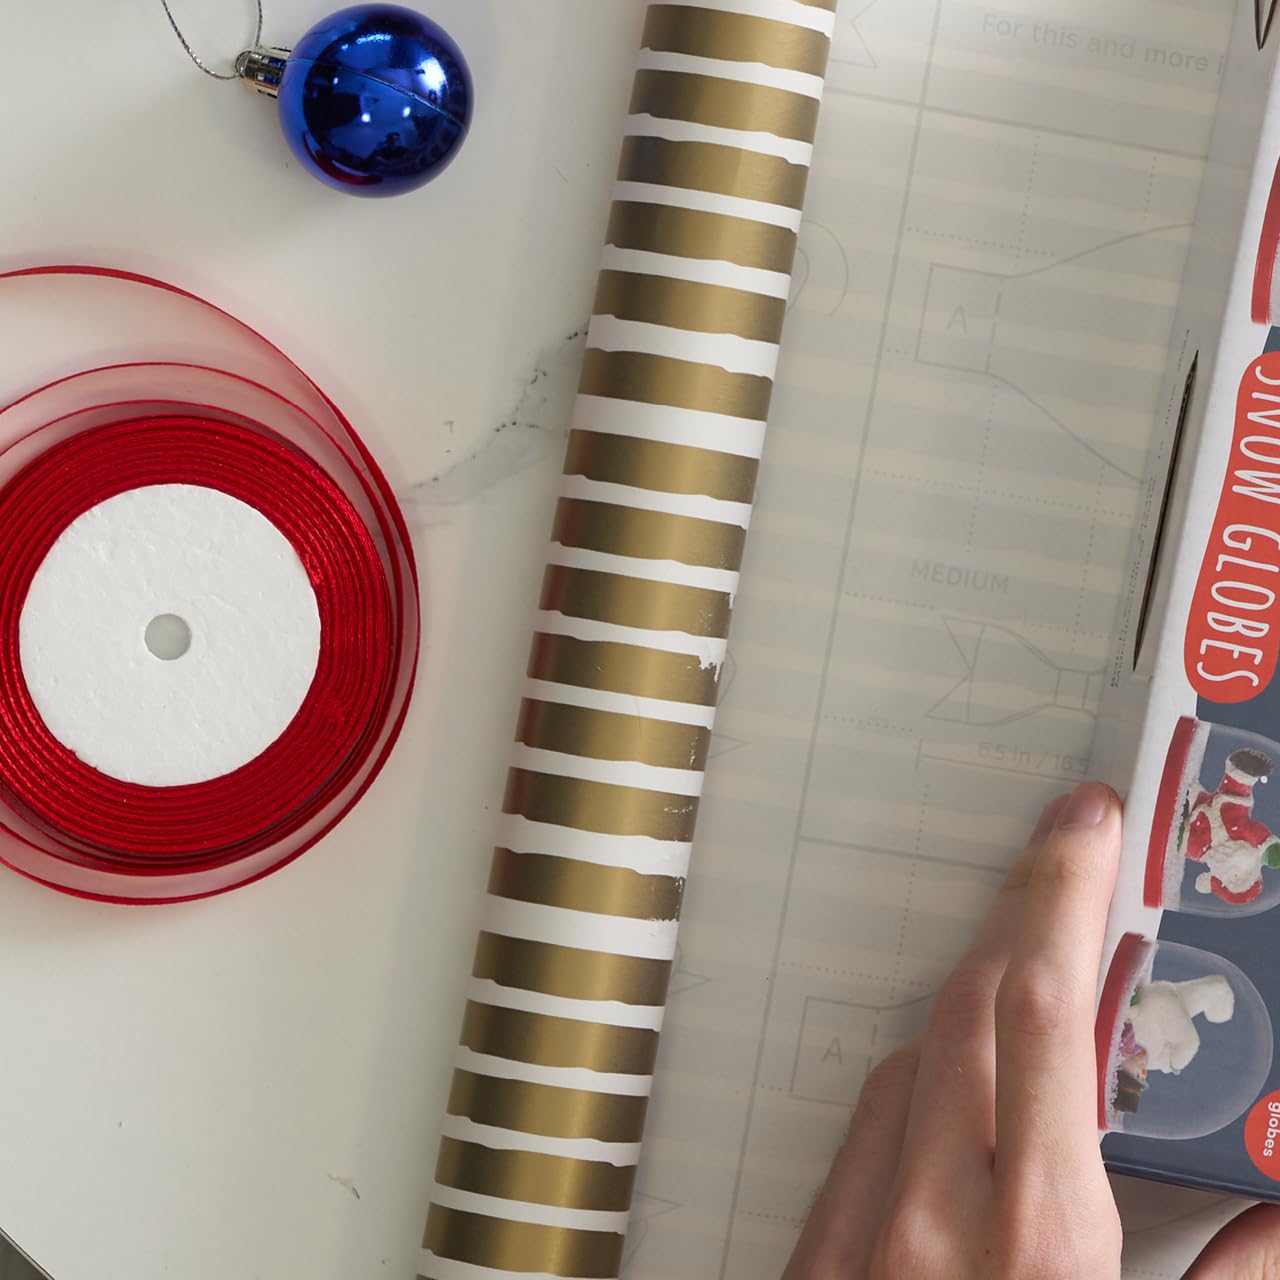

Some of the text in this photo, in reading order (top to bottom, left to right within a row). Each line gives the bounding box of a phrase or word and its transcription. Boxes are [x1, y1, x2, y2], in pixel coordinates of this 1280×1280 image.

[981, 12, 1024, 39] For
[1031, 21, 1079, 50] this
[1086, 33, 1137, 60] and
[1143, 45, 1210, 73] more
[910, 558, 1010, 595] MEDIUM
